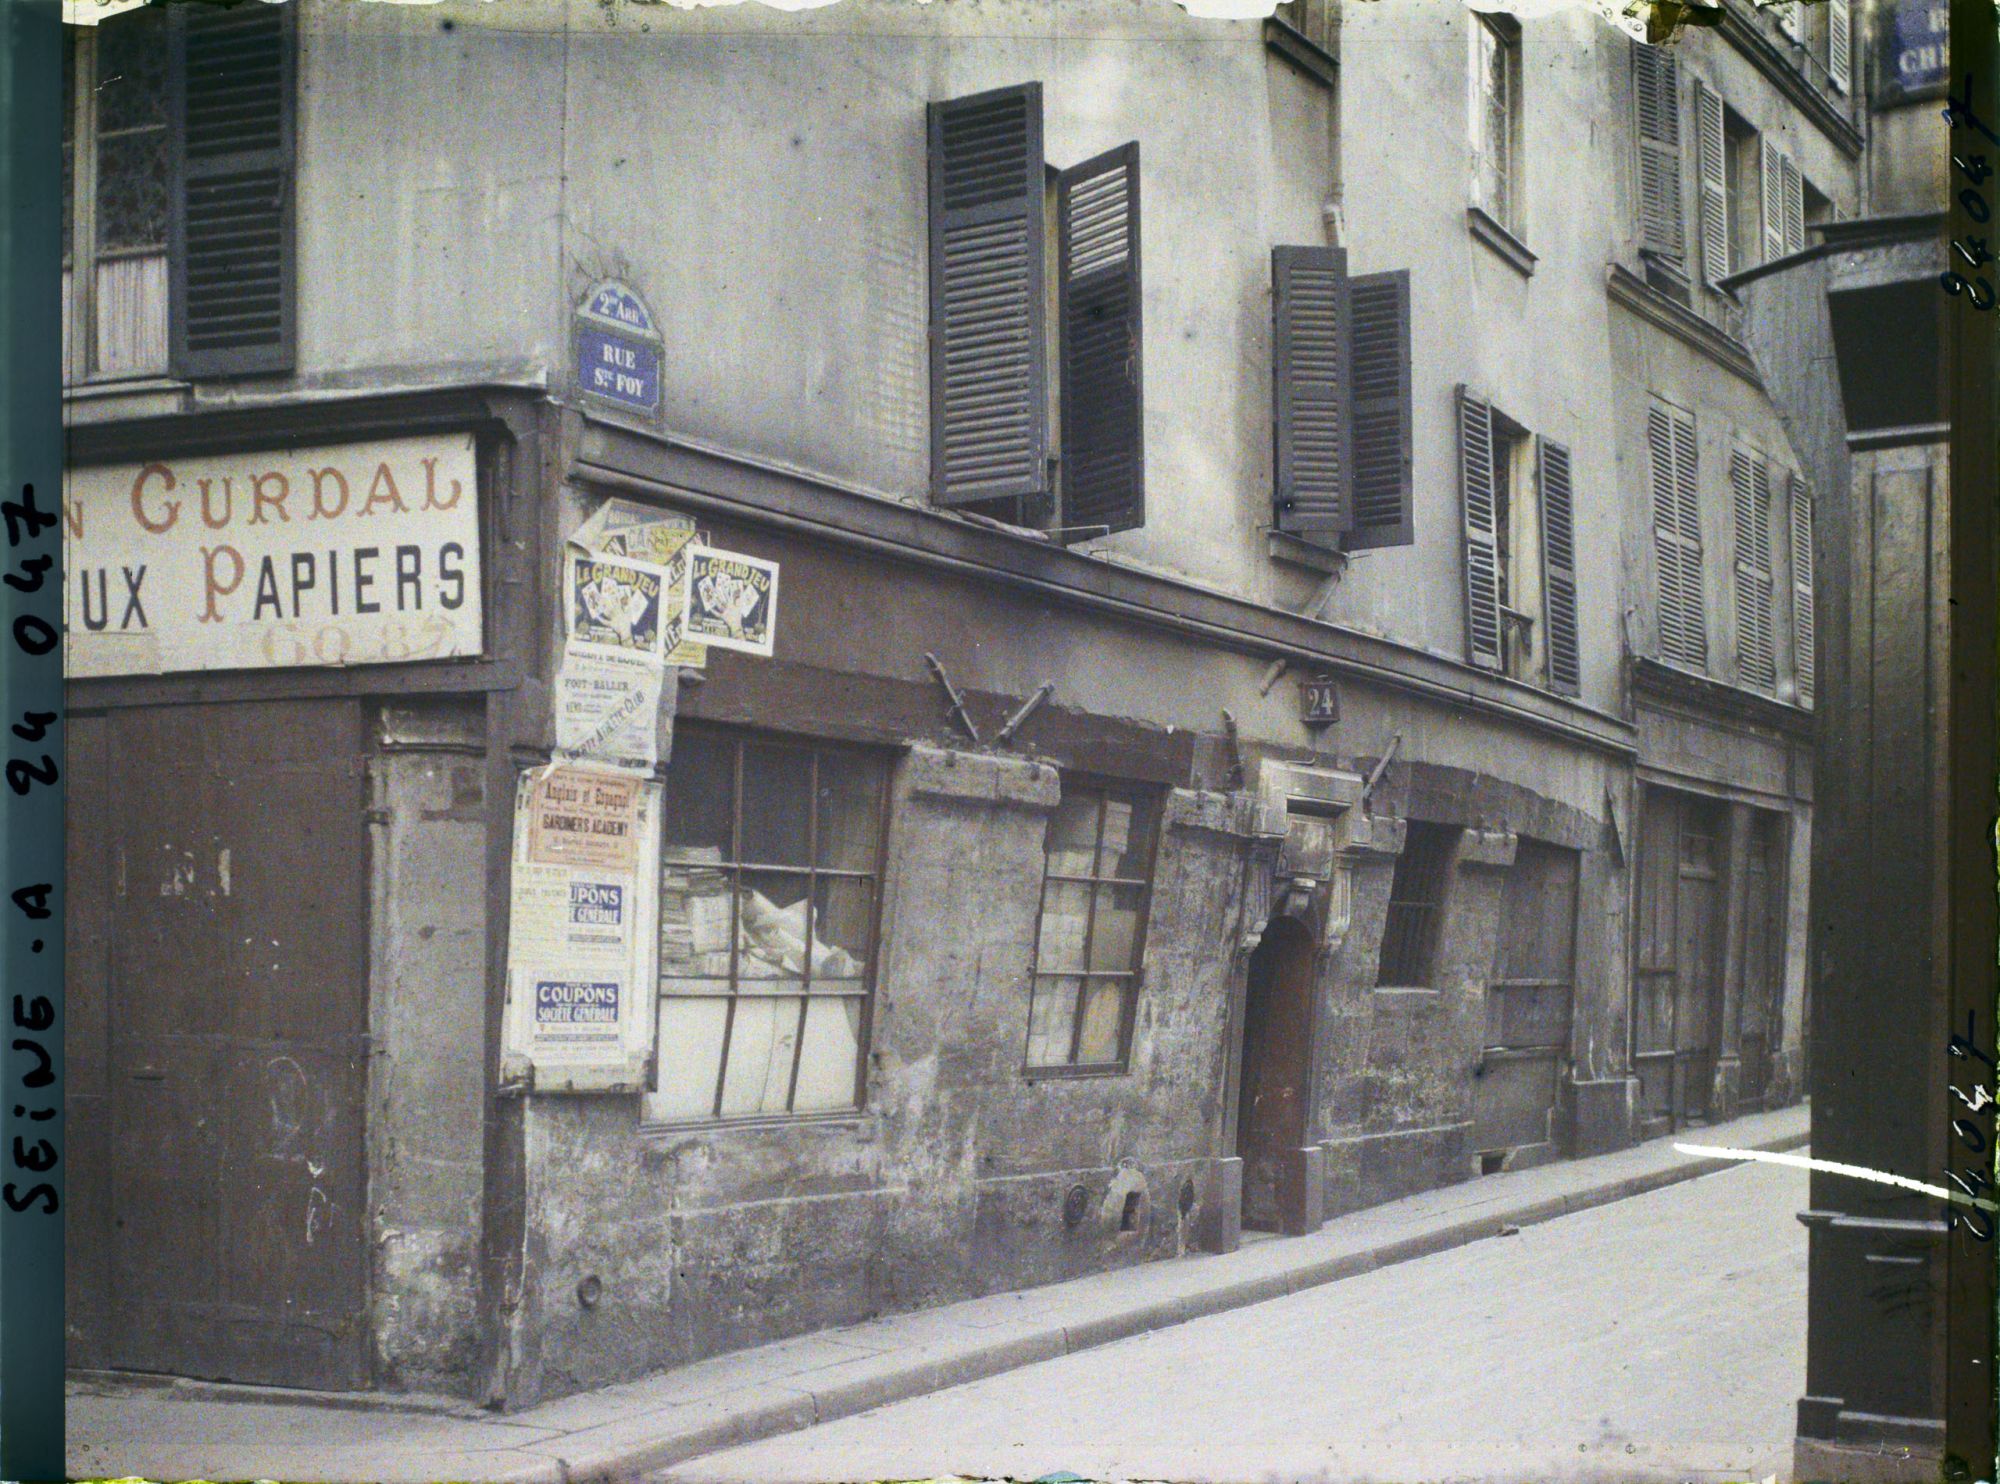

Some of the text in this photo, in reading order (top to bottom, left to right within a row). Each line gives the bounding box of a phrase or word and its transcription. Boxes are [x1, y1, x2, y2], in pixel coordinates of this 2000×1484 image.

[603, 343, 636, 370] RUE
[616, 373, 644, 397] FOY
[131, 457, 462, 534] GURDAL
[63, 542, 465, 631] UX PAPIERS
[576, 562, 660, 598] LE GRAND JEU
[694, 559, 707, 580] LE
[708, 557, 750, 580] GRAND
[744, 567, 770, 592] JEU
[1308, 688, 1334, 715] 24
[539, 986, 617, 1004] COUPONS
